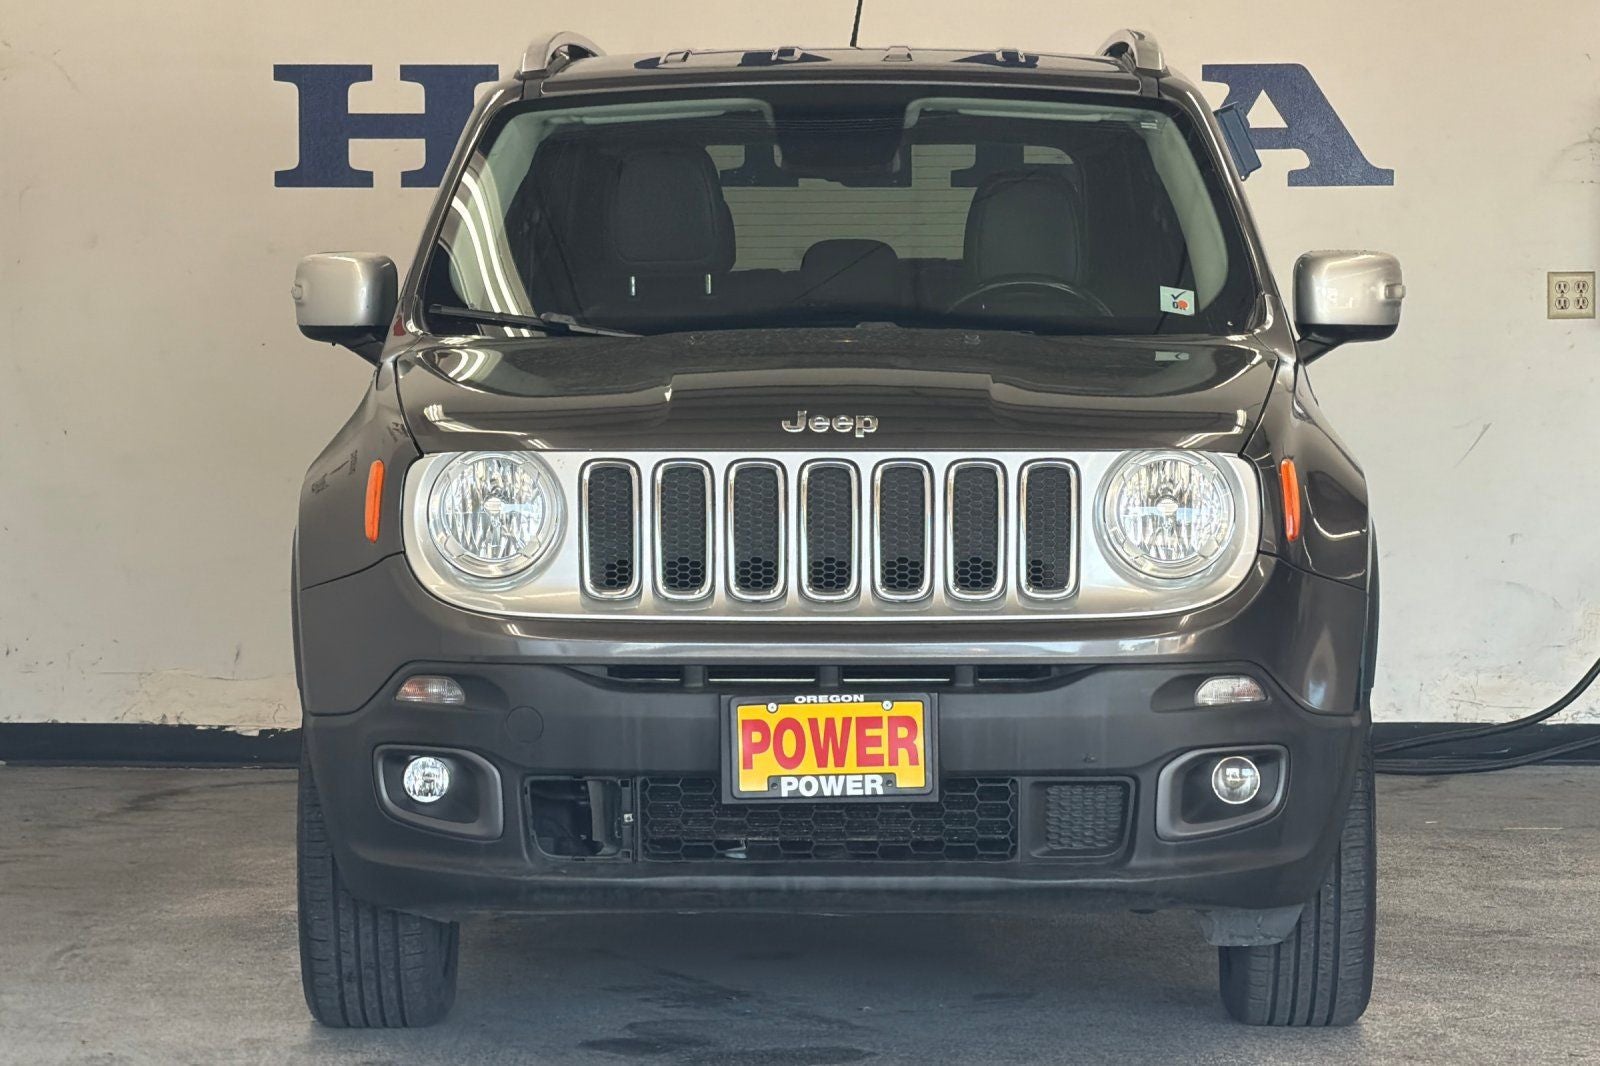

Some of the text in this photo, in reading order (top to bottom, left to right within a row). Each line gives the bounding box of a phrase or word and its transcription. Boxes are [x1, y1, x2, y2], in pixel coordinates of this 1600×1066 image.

[781, 410, 879, 438] Jeep
[794, 694, 865, 704] OREGON
[741, 715, 920, 770] POWER
[781, 774, 884, 797] POWER
